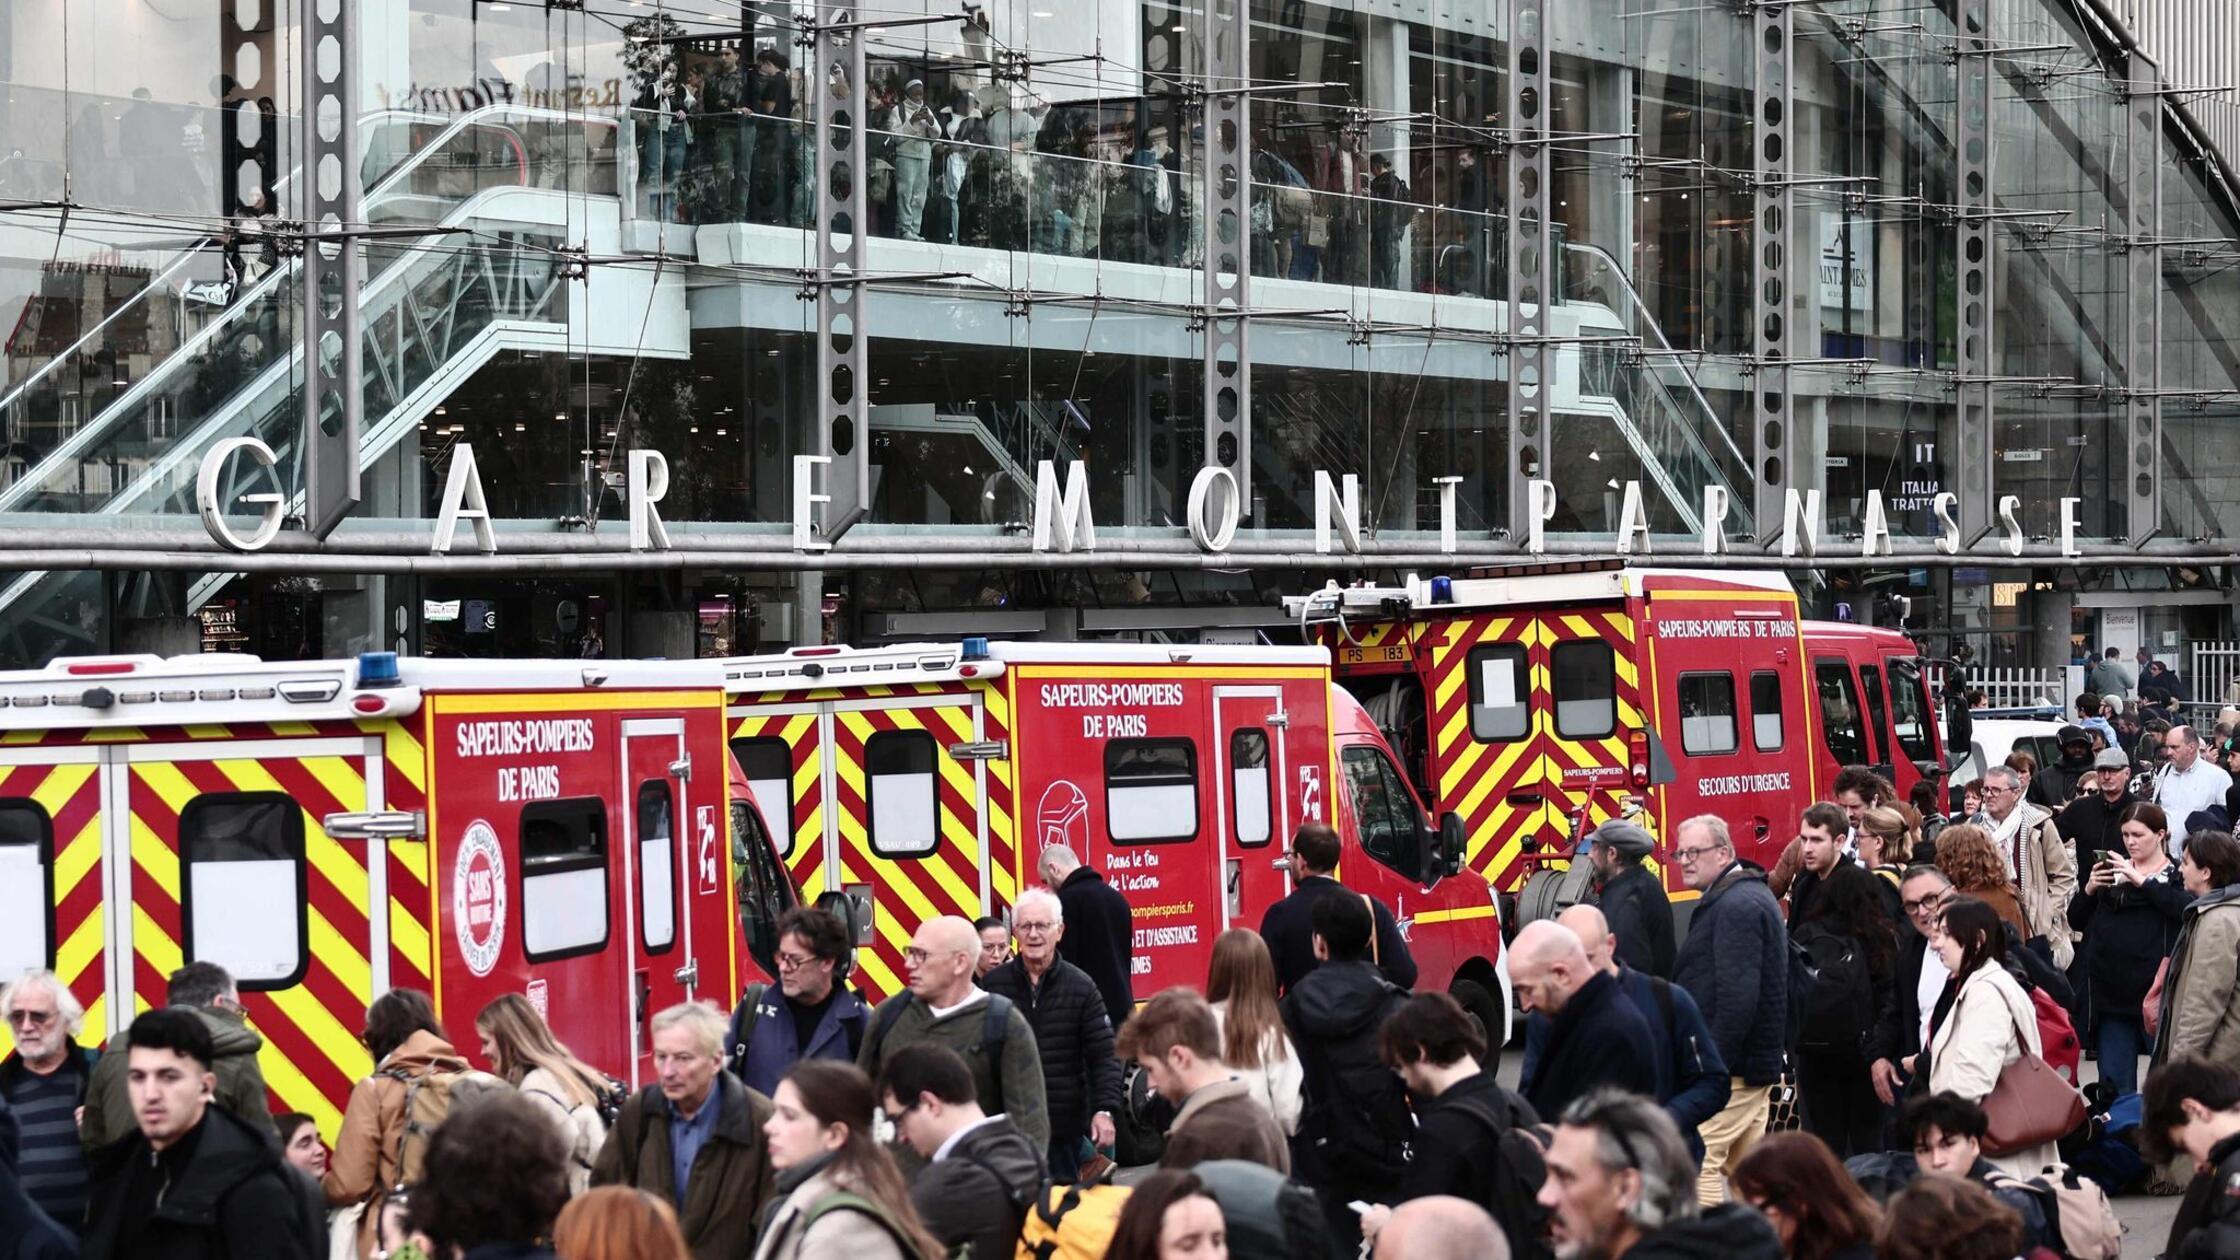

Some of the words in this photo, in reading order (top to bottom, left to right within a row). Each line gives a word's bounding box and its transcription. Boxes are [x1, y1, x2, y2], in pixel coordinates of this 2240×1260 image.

[1915, 443, 1934, 462] IT
[196, 437, 833, 552] GARE
[1032, 459, 2082, 557] MONTPARNASSE
[1901, 480, 1939, 495] ITALIA
[1658, 620, 1750, 638] SAPEURS-POMPIERS
[1754, 620, 1767, 637] DE
[1770, 620, 1796, 637] PARIS
[1348, 649, 1363, 662] PS
[1383, 647, 1404, 660] 183
[1041, 684, 1183, 707] SAPEURS-POMPIERS
[1083, 715, 1103, 738] DE
[1107, 714, 1147, 737] PARIS
[457, 718, 594, 757] SAPEURS-POMPIERS
[498, 767, 519, 801] DE
[521, 765, 560, 800] PARIS
[1698, 775, 1740, 797] SECOURS
[1741, 772, 1791, 792] D'URGENCE
[1311, 802, 1320, 821] 18
[1107, 853, 1130, 870] Dans
[1132, 850, 1142, 868] le
[1144, 849, 1158, 867] feu
[1121, 873, 1159, 890] l'action
[1135, 929, 1145, 948] ET
[1146, 925, 1198, 947] D'ASSISTANCE
